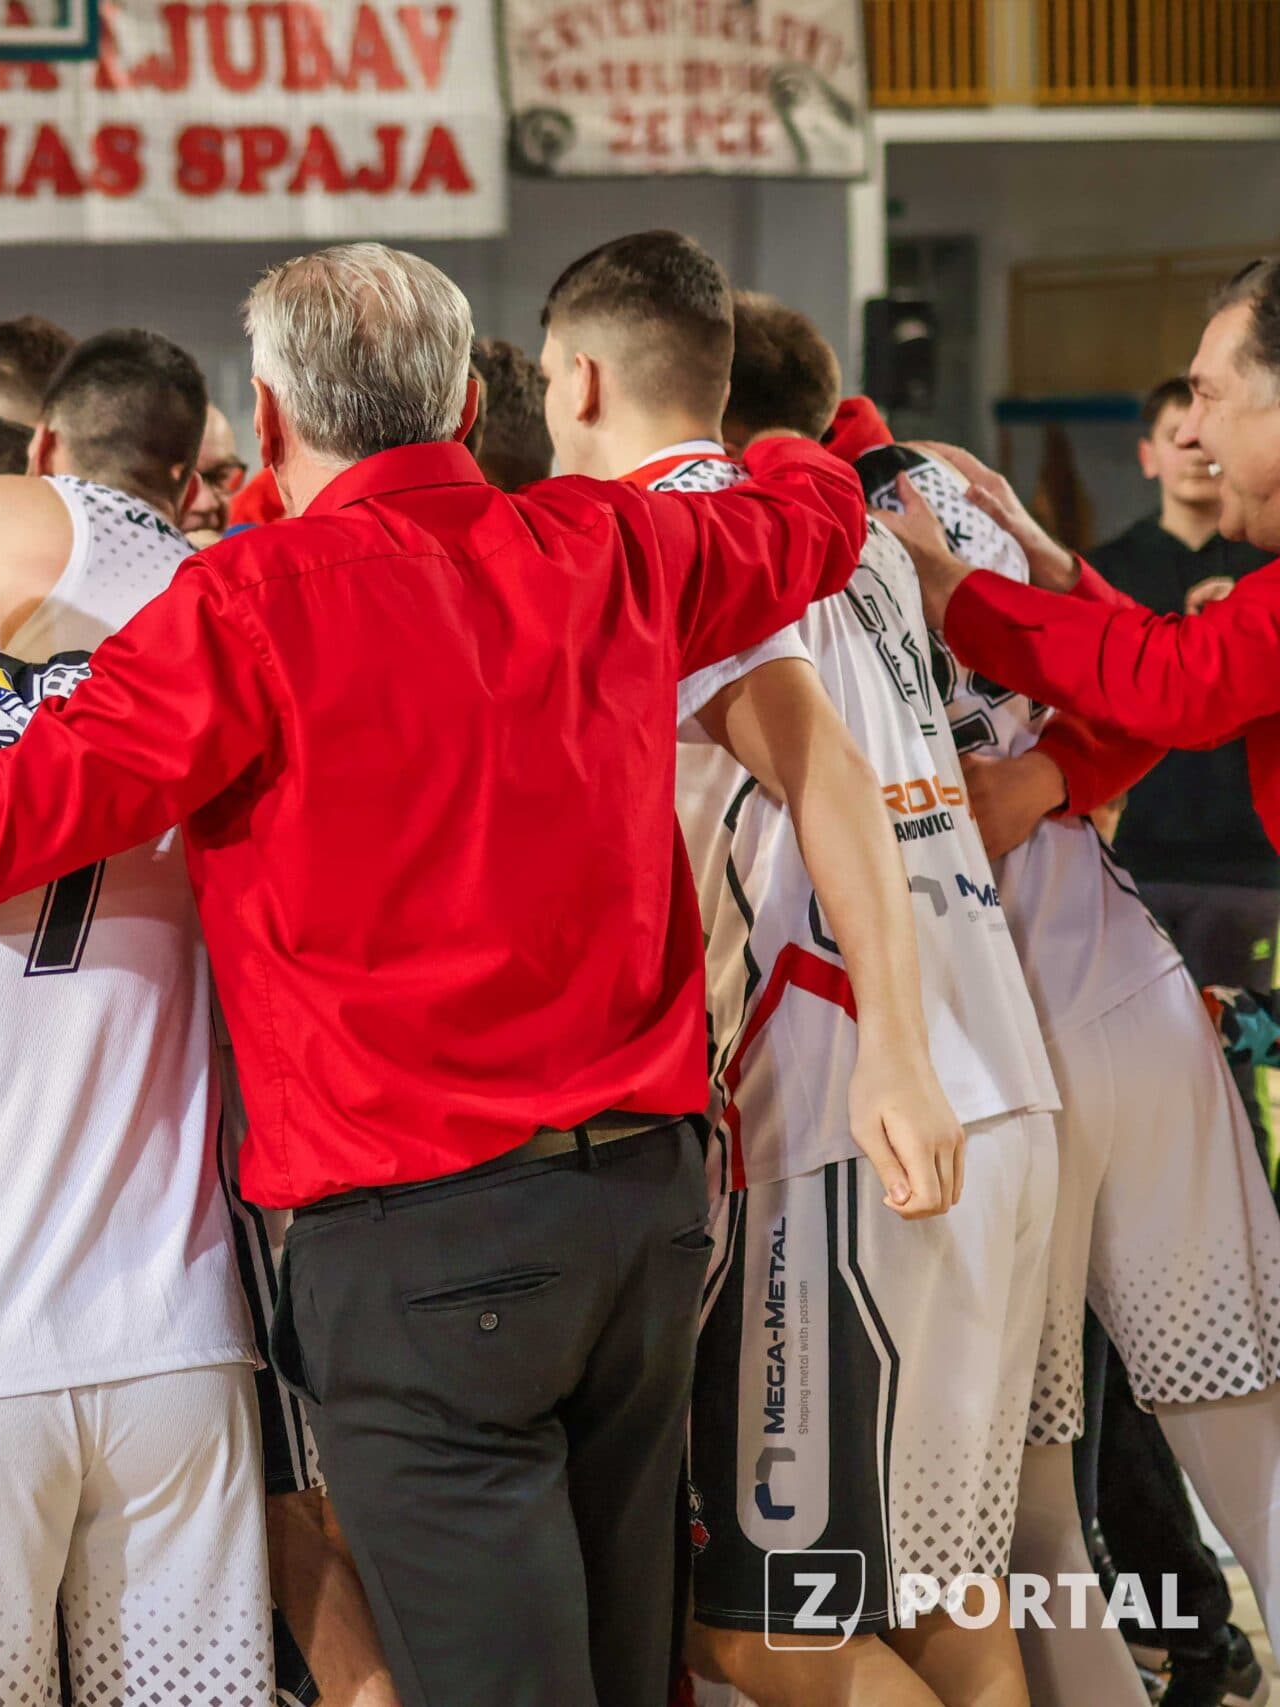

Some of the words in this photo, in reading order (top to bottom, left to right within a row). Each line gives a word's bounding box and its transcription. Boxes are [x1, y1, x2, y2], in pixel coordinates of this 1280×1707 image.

[175, 122, 475, 196] SPAJA
[799, 1279, 811, 1324] passion
[763, 1216, 787, 1435] MEGA-METAL
[799, 1327, 809, 1352] with
[799, 1354, 809, 1382] metal
[799, 1388, 811, 1435] Shaping
